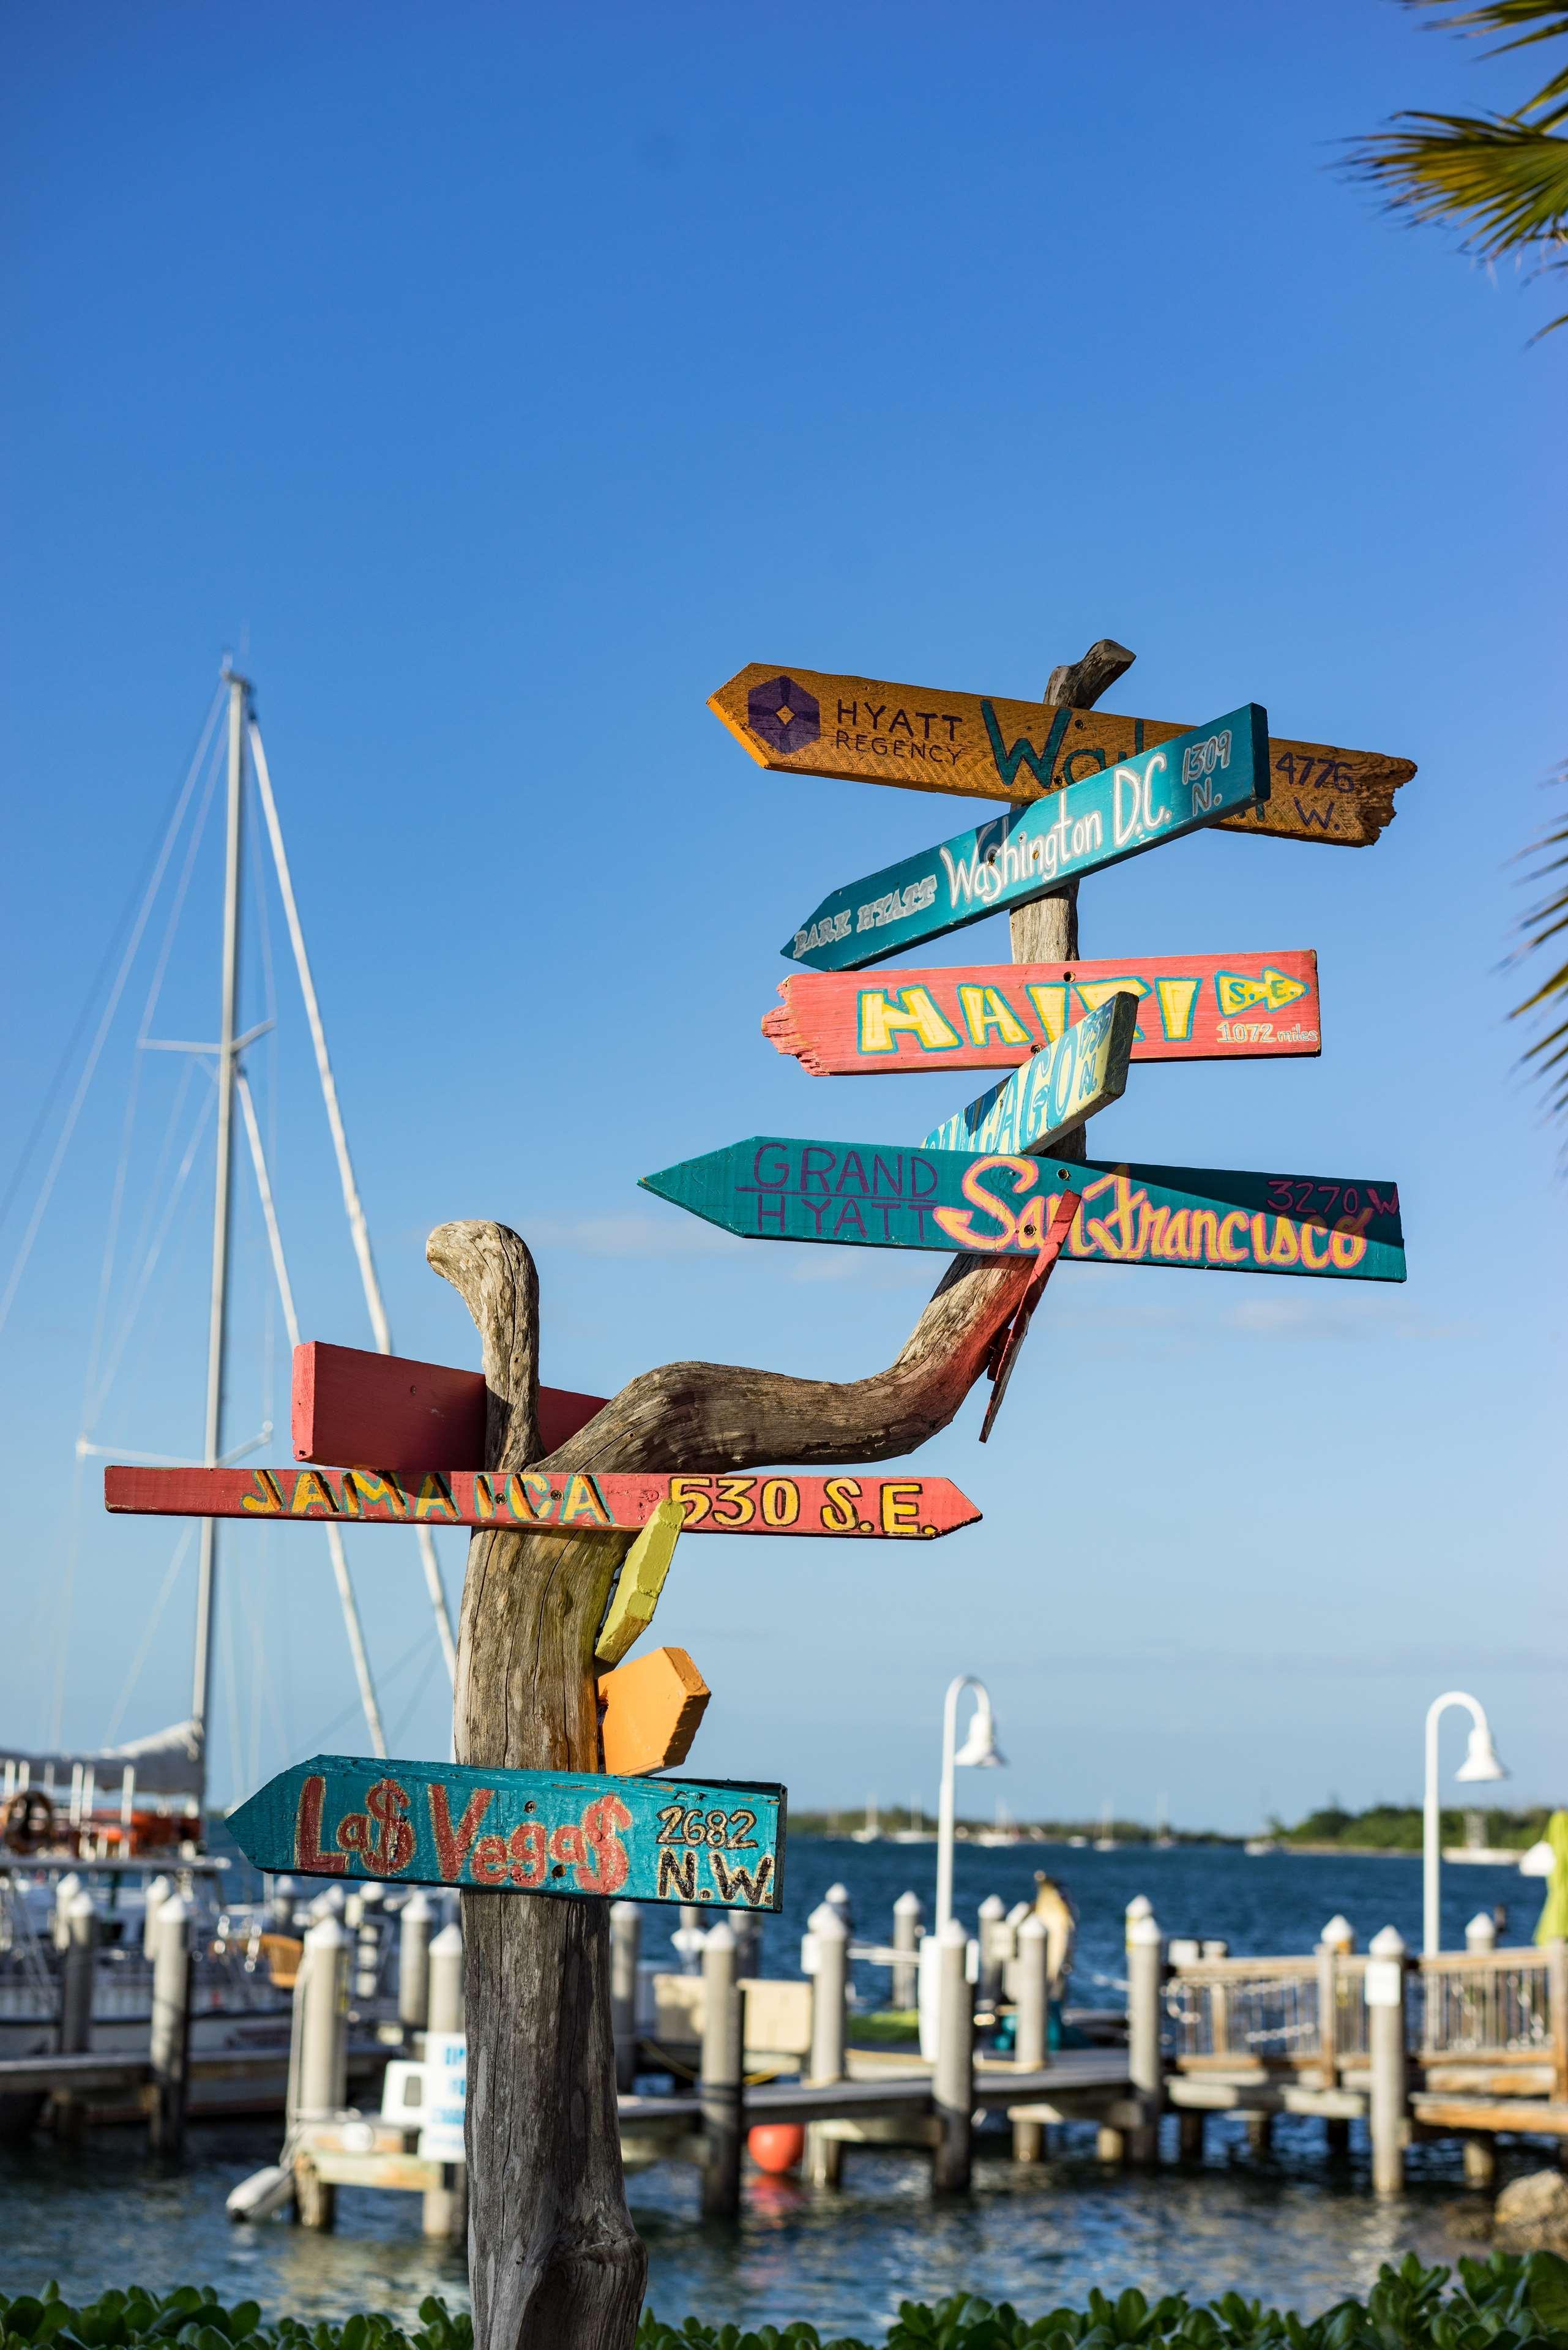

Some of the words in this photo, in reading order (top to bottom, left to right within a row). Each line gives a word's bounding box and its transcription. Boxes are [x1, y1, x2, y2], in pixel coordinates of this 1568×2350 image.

[837, 698, 963, 742] HYATT
[836, 730, 963, 766] REGENCY
[1182, 729, 1233, 786] 1309
[1275, 751, 1355, 793] 4776
[1192, 777, 1223, 817] N.
[1293, 796, 1340, 831] W.
[793, 908, 852, 959] PARK
[857, 874, 938, 934] HYATT
[940, 790, 1102, 907] Washington
[1112, 752, 1172, 849] D.C.
[1215, 1021, 1275, 1043] 1072
[1277, 1023, 1318, 1042] miles
[753, 1142, 938, 1198] GRAND
[758, 1194, 938, 1243] HYATT
[1082, 1163, 1375, 1270] Francisco
[1266, 1180, 1359, 1214] 3270
[1365, 1184, 1400, 1216] W
[240, 1470, 615, 1525] JAMAICA
[669, 1476, 801, 1527] 530
[656, 1804, 759, 1850] 2682
[658, 1846, 774, 1906] N.W.
